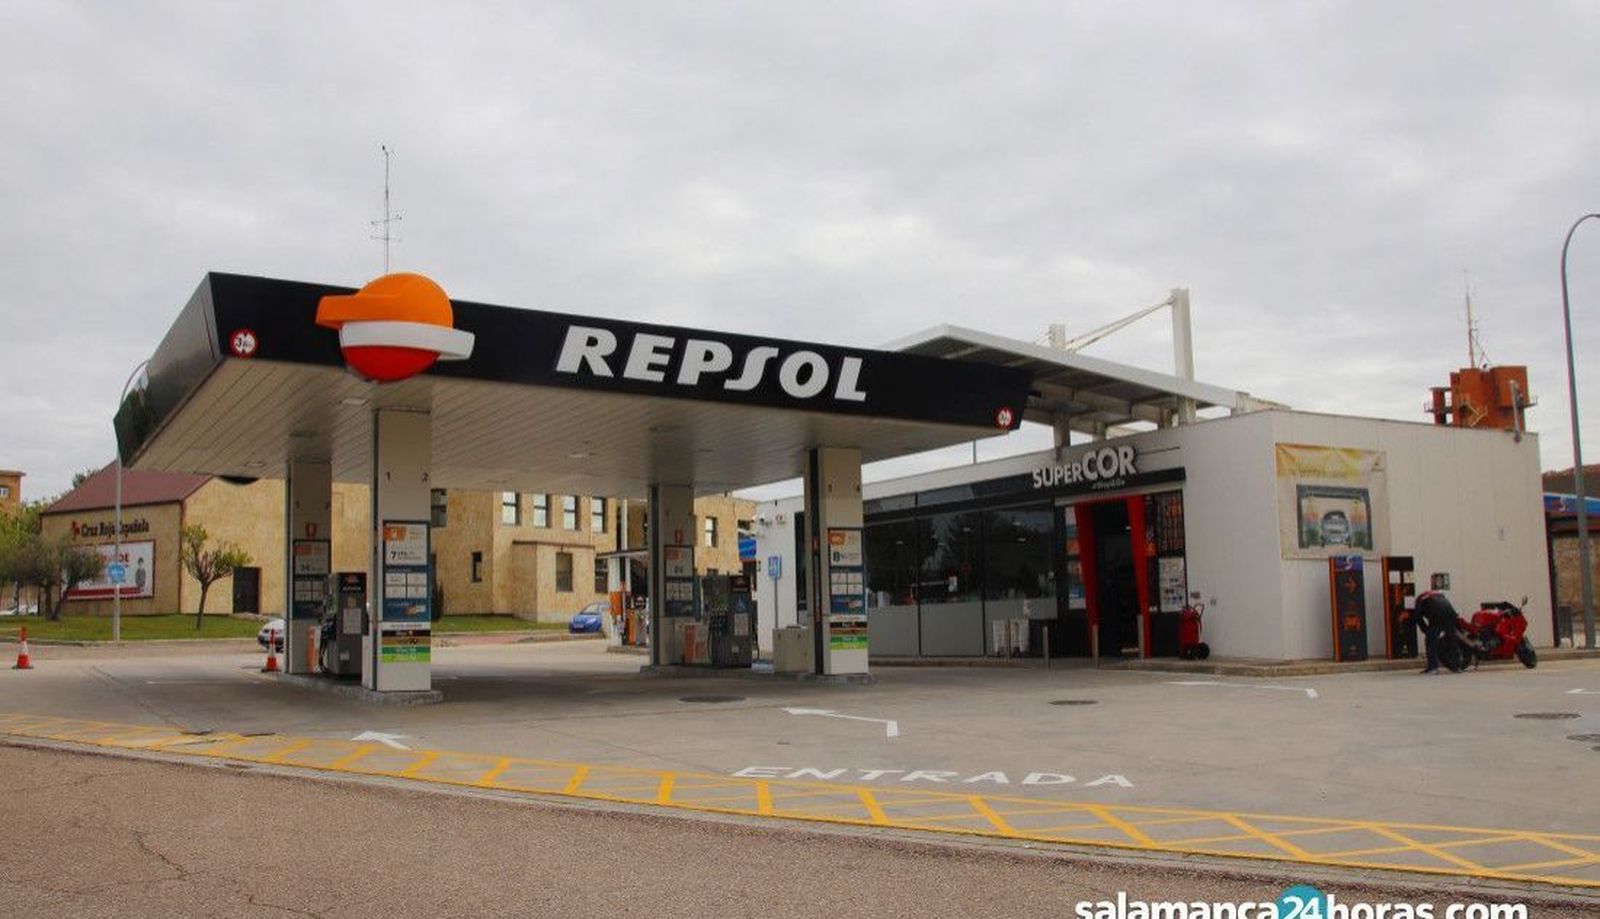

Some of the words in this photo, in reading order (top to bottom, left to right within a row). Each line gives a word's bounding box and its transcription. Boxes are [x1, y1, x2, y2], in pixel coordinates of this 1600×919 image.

[556, 324, 867, 402] REPSOL
[1032, 445, 1137, 489] SUPERCOR
[82, 523, 98, 538] Cruz
[733, 766, 1134, 788] ENTRADA
